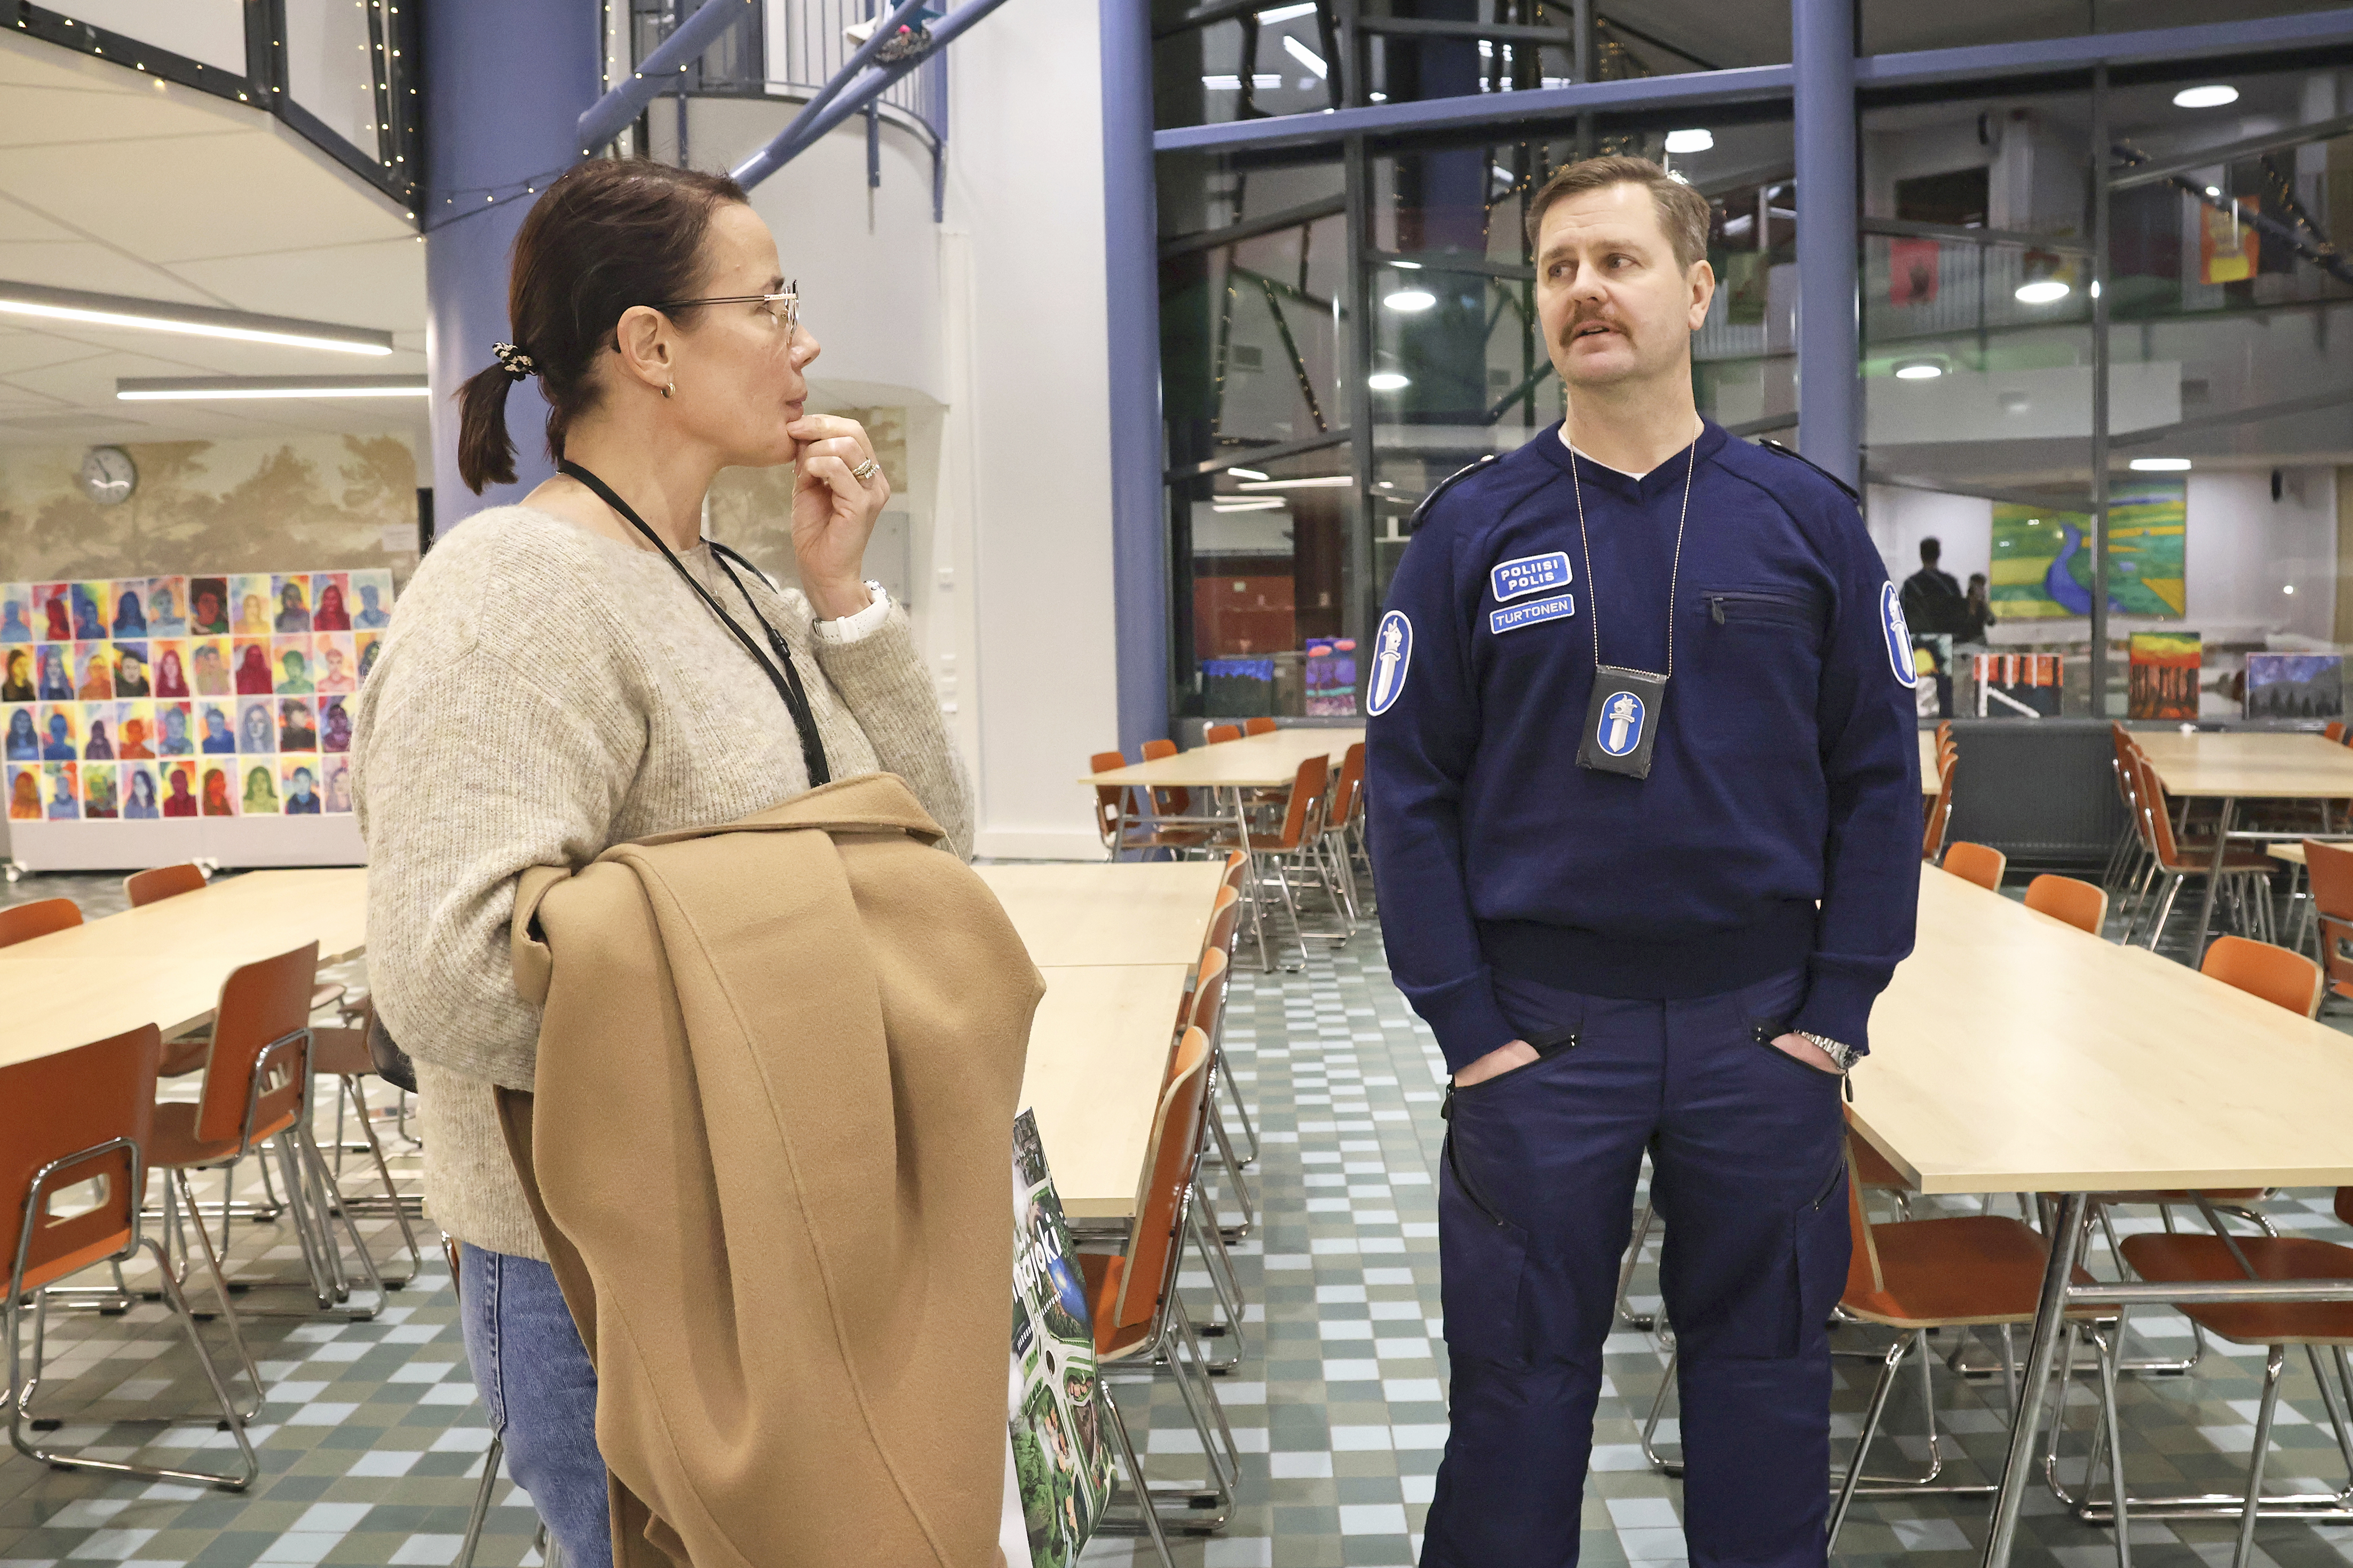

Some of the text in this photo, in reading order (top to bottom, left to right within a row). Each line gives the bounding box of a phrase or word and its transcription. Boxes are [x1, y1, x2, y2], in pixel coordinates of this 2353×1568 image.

[1501, 559, 1558, 581] POLIISI
[1508, 571, 1555, 591] POLIS
[1496, 600, 1568, 626] TURTONEN
[1012, 1212, 1062, 1304] näjoki
